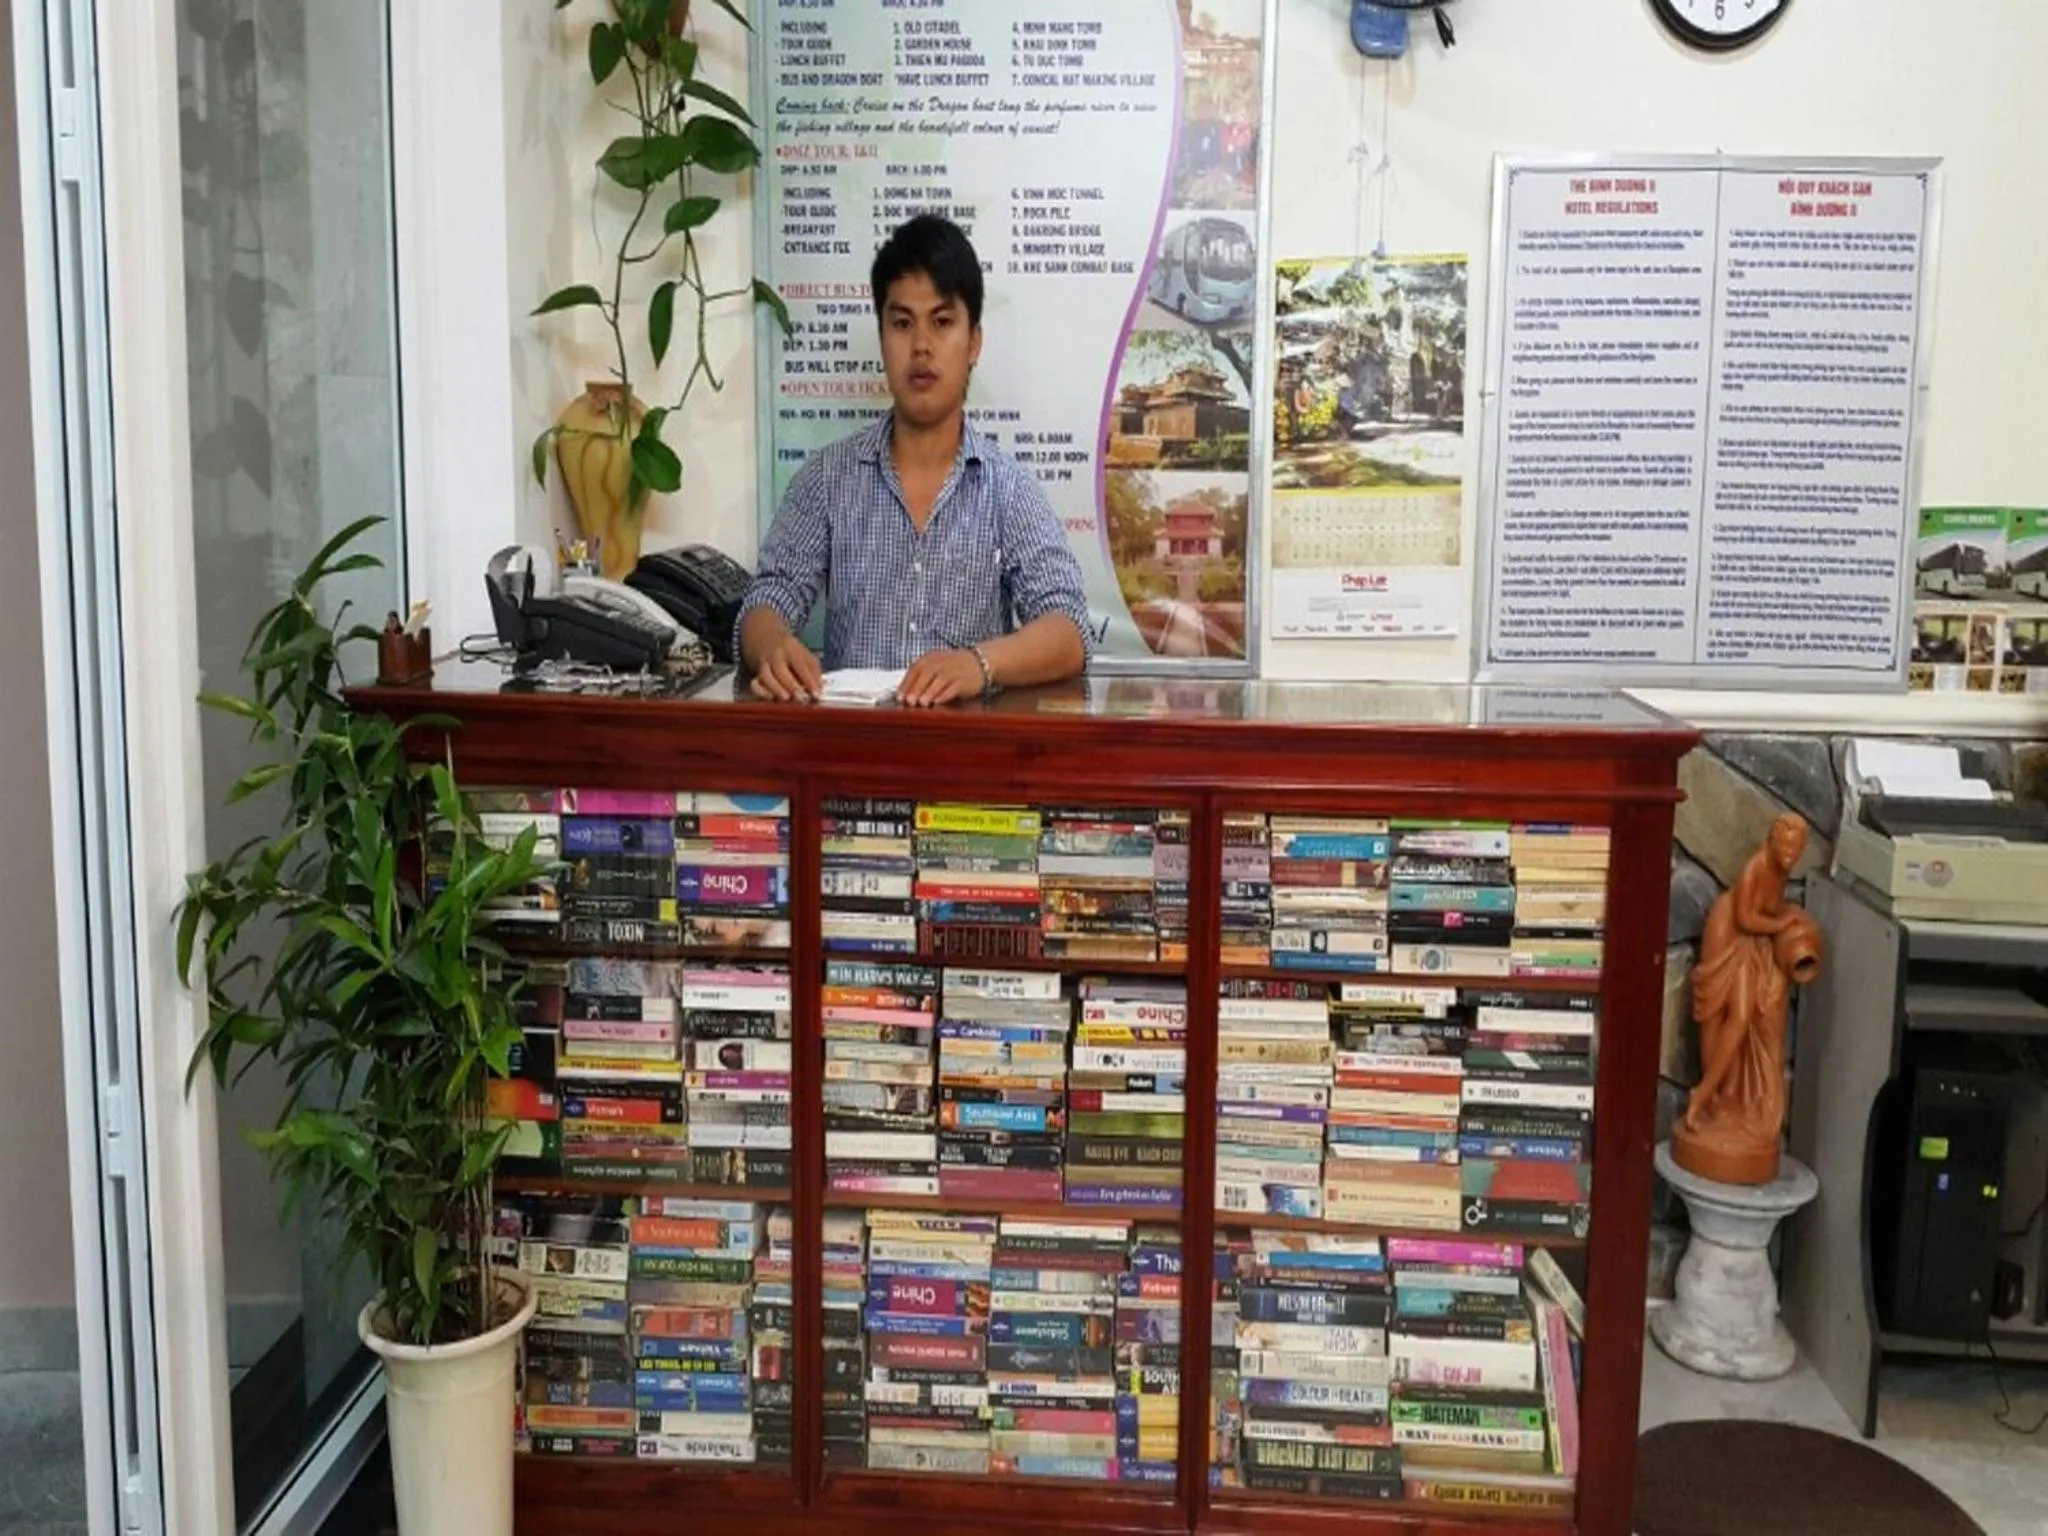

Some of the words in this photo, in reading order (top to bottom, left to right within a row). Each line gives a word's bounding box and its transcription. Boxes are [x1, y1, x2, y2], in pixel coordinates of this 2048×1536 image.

[904, 22, 921, 33] OLD
[924, 22, 961, 34] CITADEL
[781, 38, 804, 50] TOUR
[806, 39, 831, 49] GUIDE
[904, 38, 940, 50] GARDEN
[943, 38, 972, 50] HOUSE
[781, 54, 810, 66] LUNCH
[813, 54, 846, 66] BUFFET
[950, 54, 986, 67] PAGODA
[781, 73, 799, 86] BUS
[802, 73, 820, 86] AND
[822, 73, 858, 86] DRAGON
[860, 73, 883, 86] BOAT
[924, 74, 952, 86] LUNCH
[955, 74, 989, 86] BUFFET
[1023, 74, 1059, 86] CONICAL
[1063, 74, 1080, 86] HAT
[1083, 74, 1117, 86] MAKING
[1120, 74, 1156, 86] VILLAGE
[776, 96, 817, 113] Coming
[852, 96, 888, 112] Cruise
[892, 103, 904, 112] on
[908, 99, 924, 112] the
[928, 96, 968, 114] Dragon
[972, 98, 996, 112] boat
[1024, 98, 1042, 112] the
[1044, 99, 1087, 115] perfume
[776, 121, 792, 132] the
[794, 120, 831, 137] fishing
[835, 120, 872, 137] village
[875, 121, 894, 133] and
[899, 120, 914, 133] the
[1008, 121, 1020, 138] of
[1615, 179, 1646, 192] DUONG
[884, 187, 909, 200] DONG
[927, 187, 953, 199] TOWN
[1070, 188, 1104, 200] TUNNEL
[809, 206, 836, 217] GUIDE
[953, 206, 976, 218] BASE
[1565, 201, 1592, 213] HOTEL
[1595, 201, 1658, 214] REGULATIONS
[1068, 224, 1101, 237] BRIDGE
[833, 242, 851, 253] FEE
[1023, 243, 1065, 255] MINORITY
[1069, 244, 1105, 256] VILLAGE
[1071, 262, 1107, 273] COMBAT
[1110, 262, 1134, 274] BASE
[785, 361, 804, 373] BUS
[807, 361, 831, 373] WILL
[834, 361, 858, 373] STOP
[607, 922, 645, 942] TOXIN
